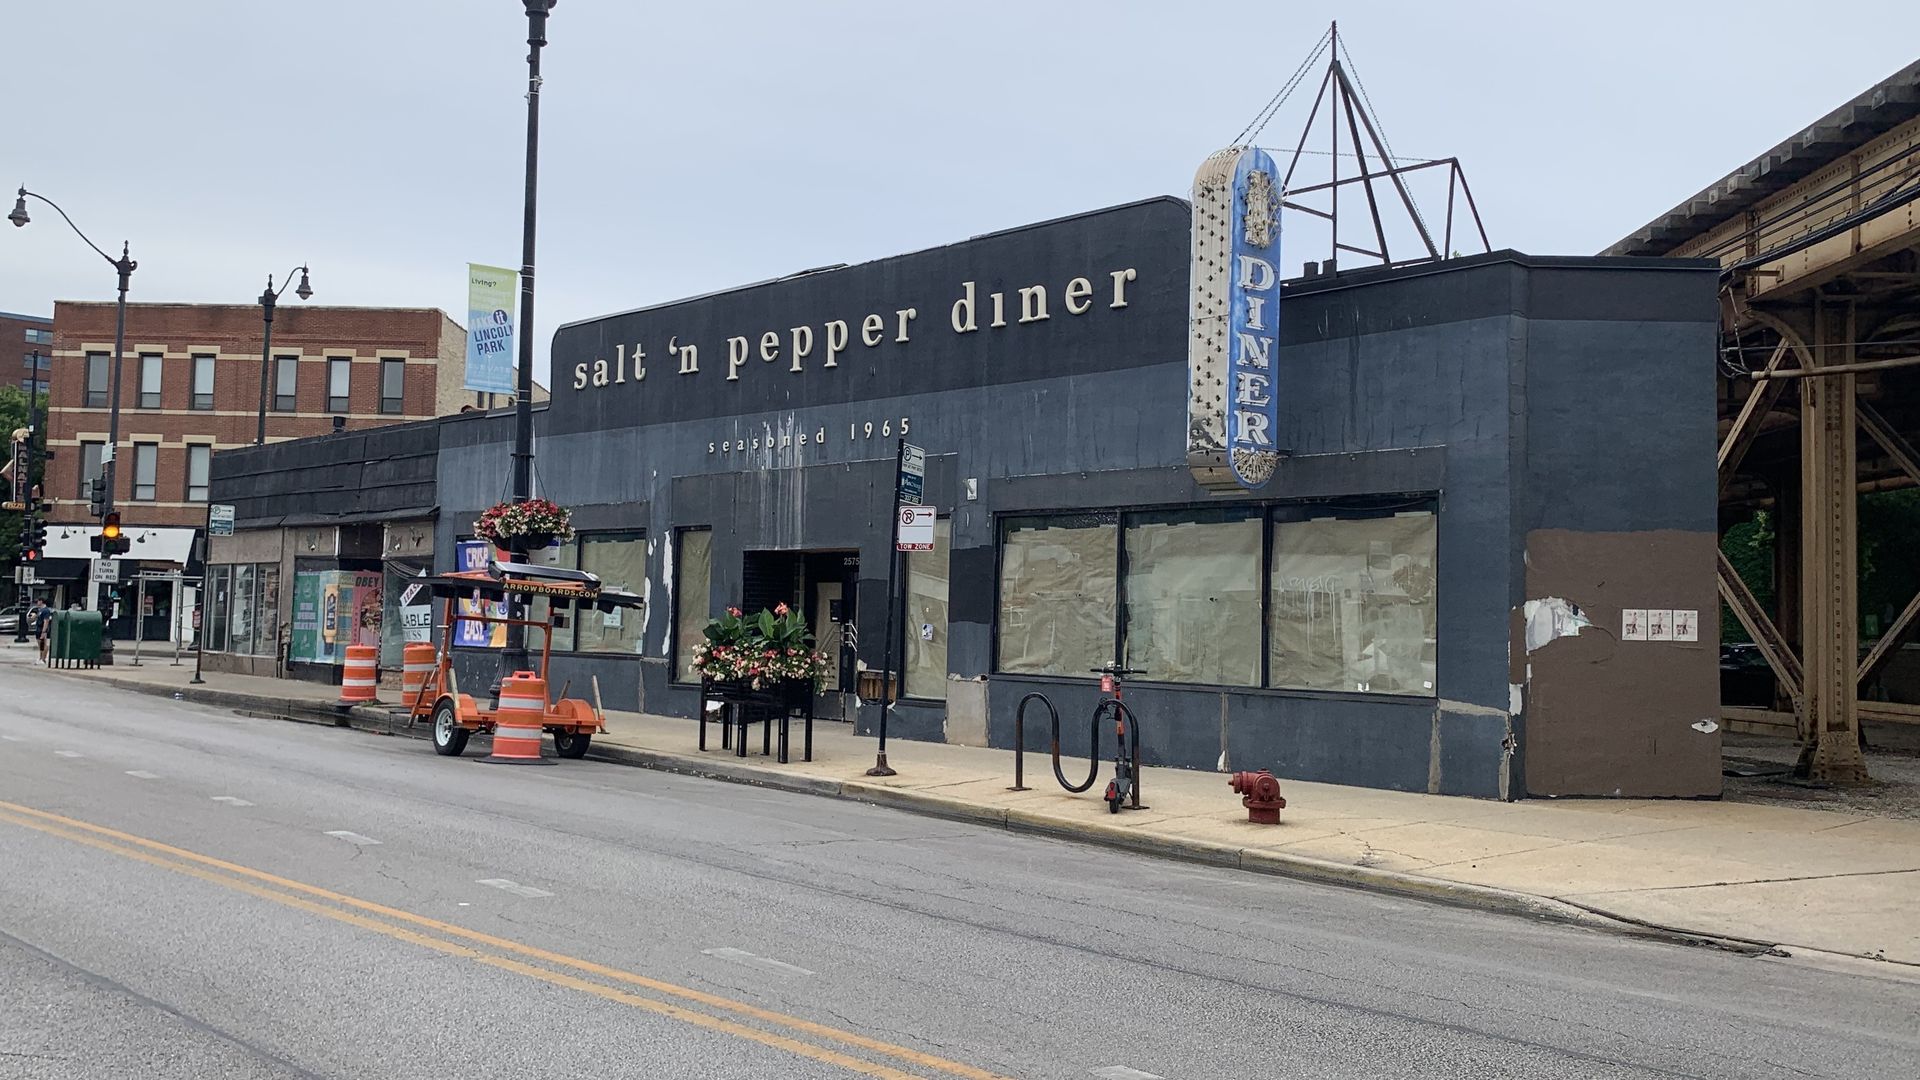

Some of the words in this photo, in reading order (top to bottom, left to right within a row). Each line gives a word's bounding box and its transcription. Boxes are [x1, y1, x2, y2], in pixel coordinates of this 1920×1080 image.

[573, 343, 648, 390] salt
[726, 307, 917, 380] pepper
[951, 268, 1137, 334] diner
[477, 339, 506, 356] PARK
[1235, 254, 1275, 446] DINER
[708, 427, 825, 454] seasoned
[851, 418, 910, 440] 1965
[843, 557, 861, 566] 2575
[355, 576, 379, 587] OBEY
[503, 583, 598, 599] ARROWBOARDS.COM
